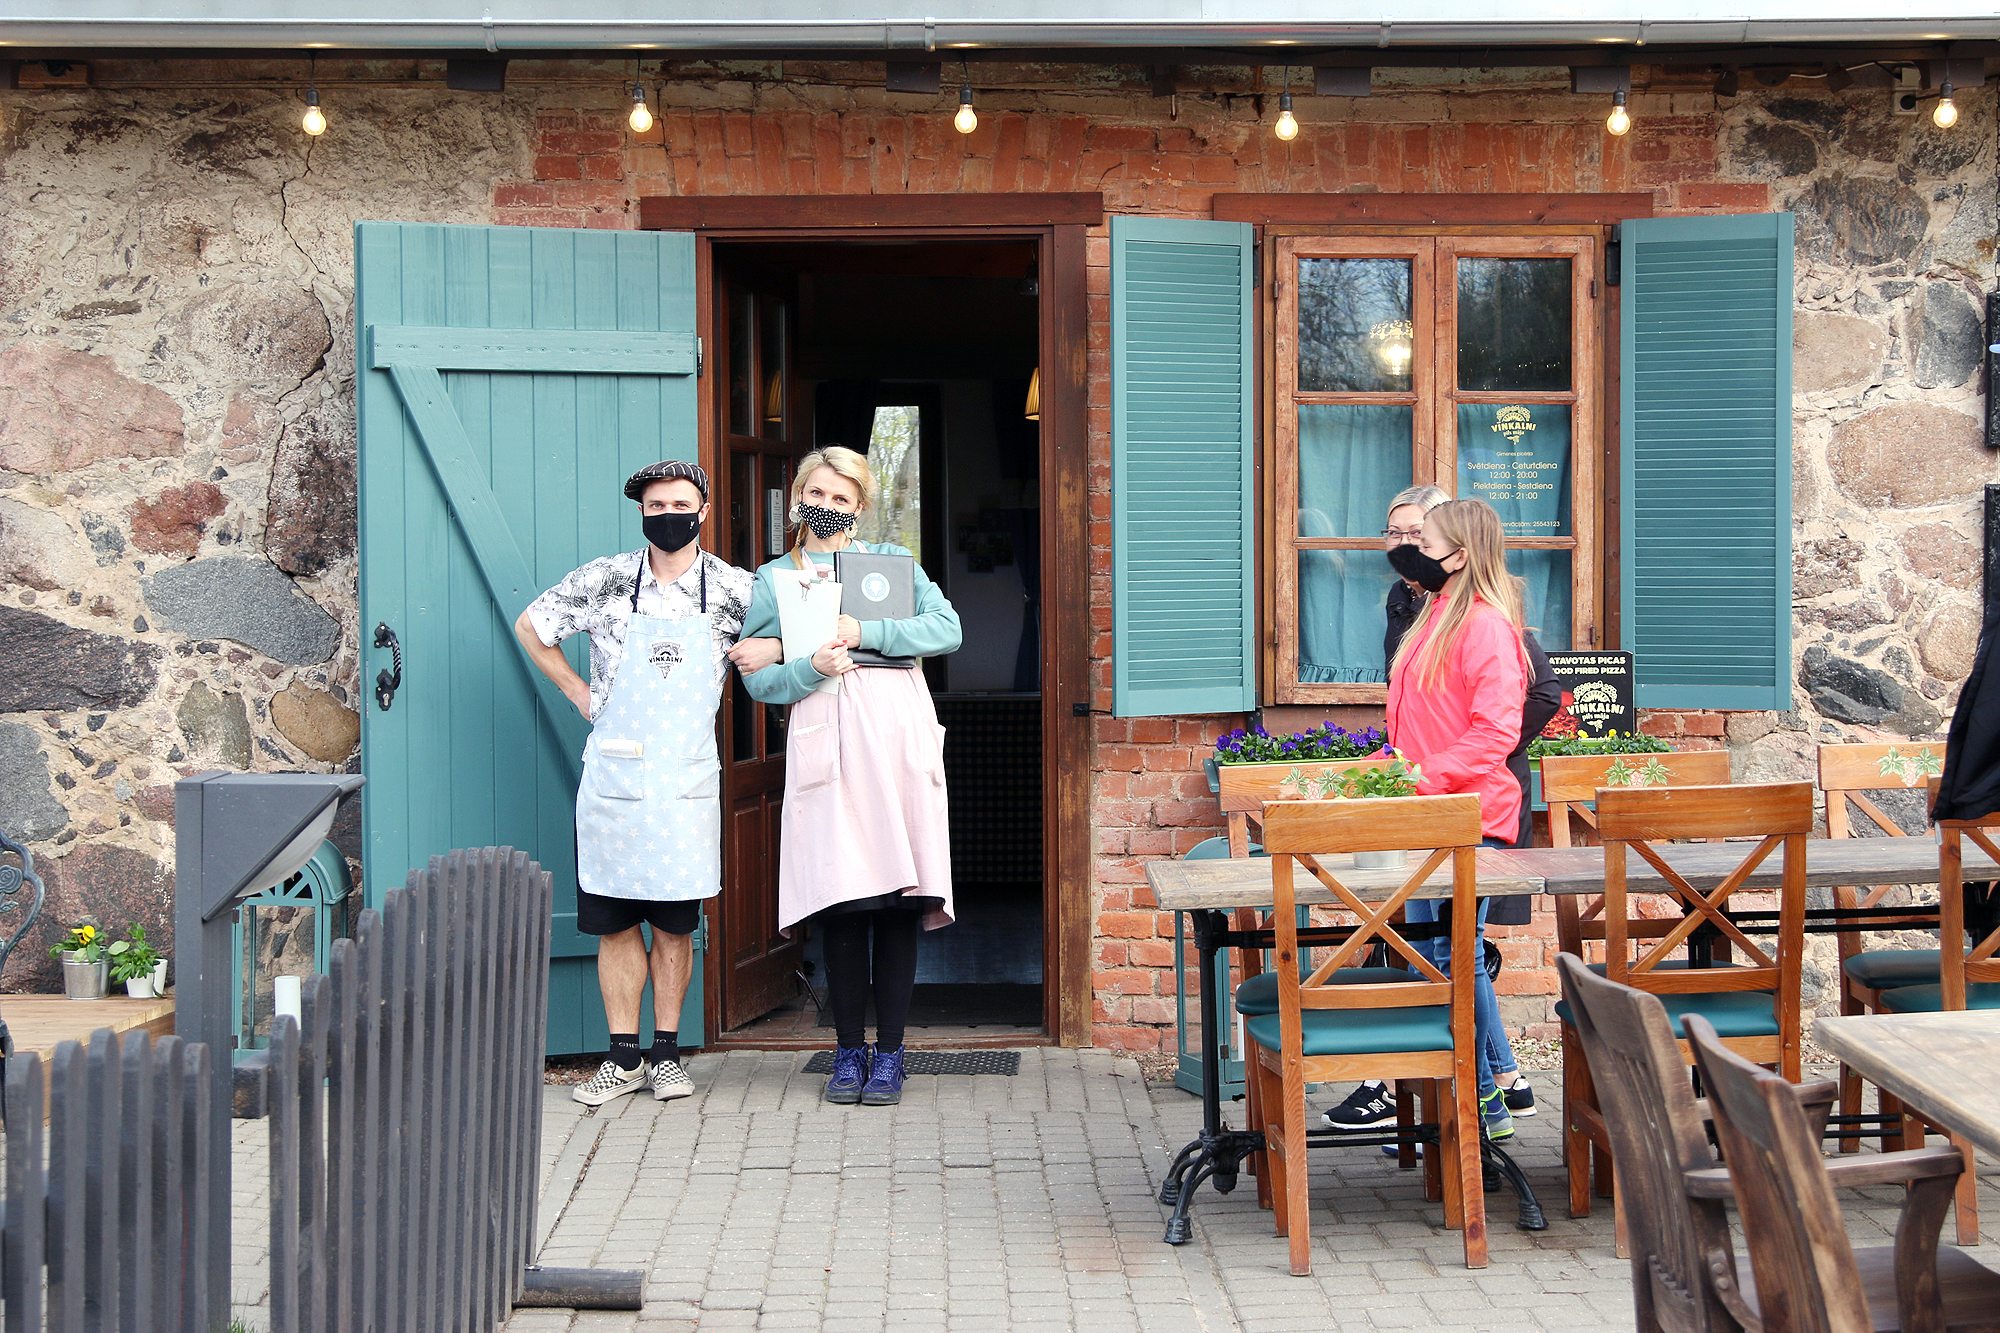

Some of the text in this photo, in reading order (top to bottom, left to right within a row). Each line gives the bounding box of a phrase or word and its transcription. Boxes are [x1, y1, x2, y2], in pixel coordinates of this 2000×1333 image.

[1467, 462, 1506, 470] Svētdiena
[1511, 462, 1558, 470] Ceturtdiena
[1489, 471, 1511, 479] 12:00
[1516, 471, 1538, 479] 20:00
[1473, 482, 1512, 490] Piektdiena
[1517, 482, 1554, 490] Sestdiena
[1489, 491, 1510, 500] 12:00
[1516, 491, 1538, 500] 21:00
[1549, 656, 1626, 665] ATAVOTAS PICAS
[1574, 667, 1600, 675] FIRED
[1600, 667, 1627, 675] PIZZA
[1566, 701, 1625, 716] VĪNKALNI
